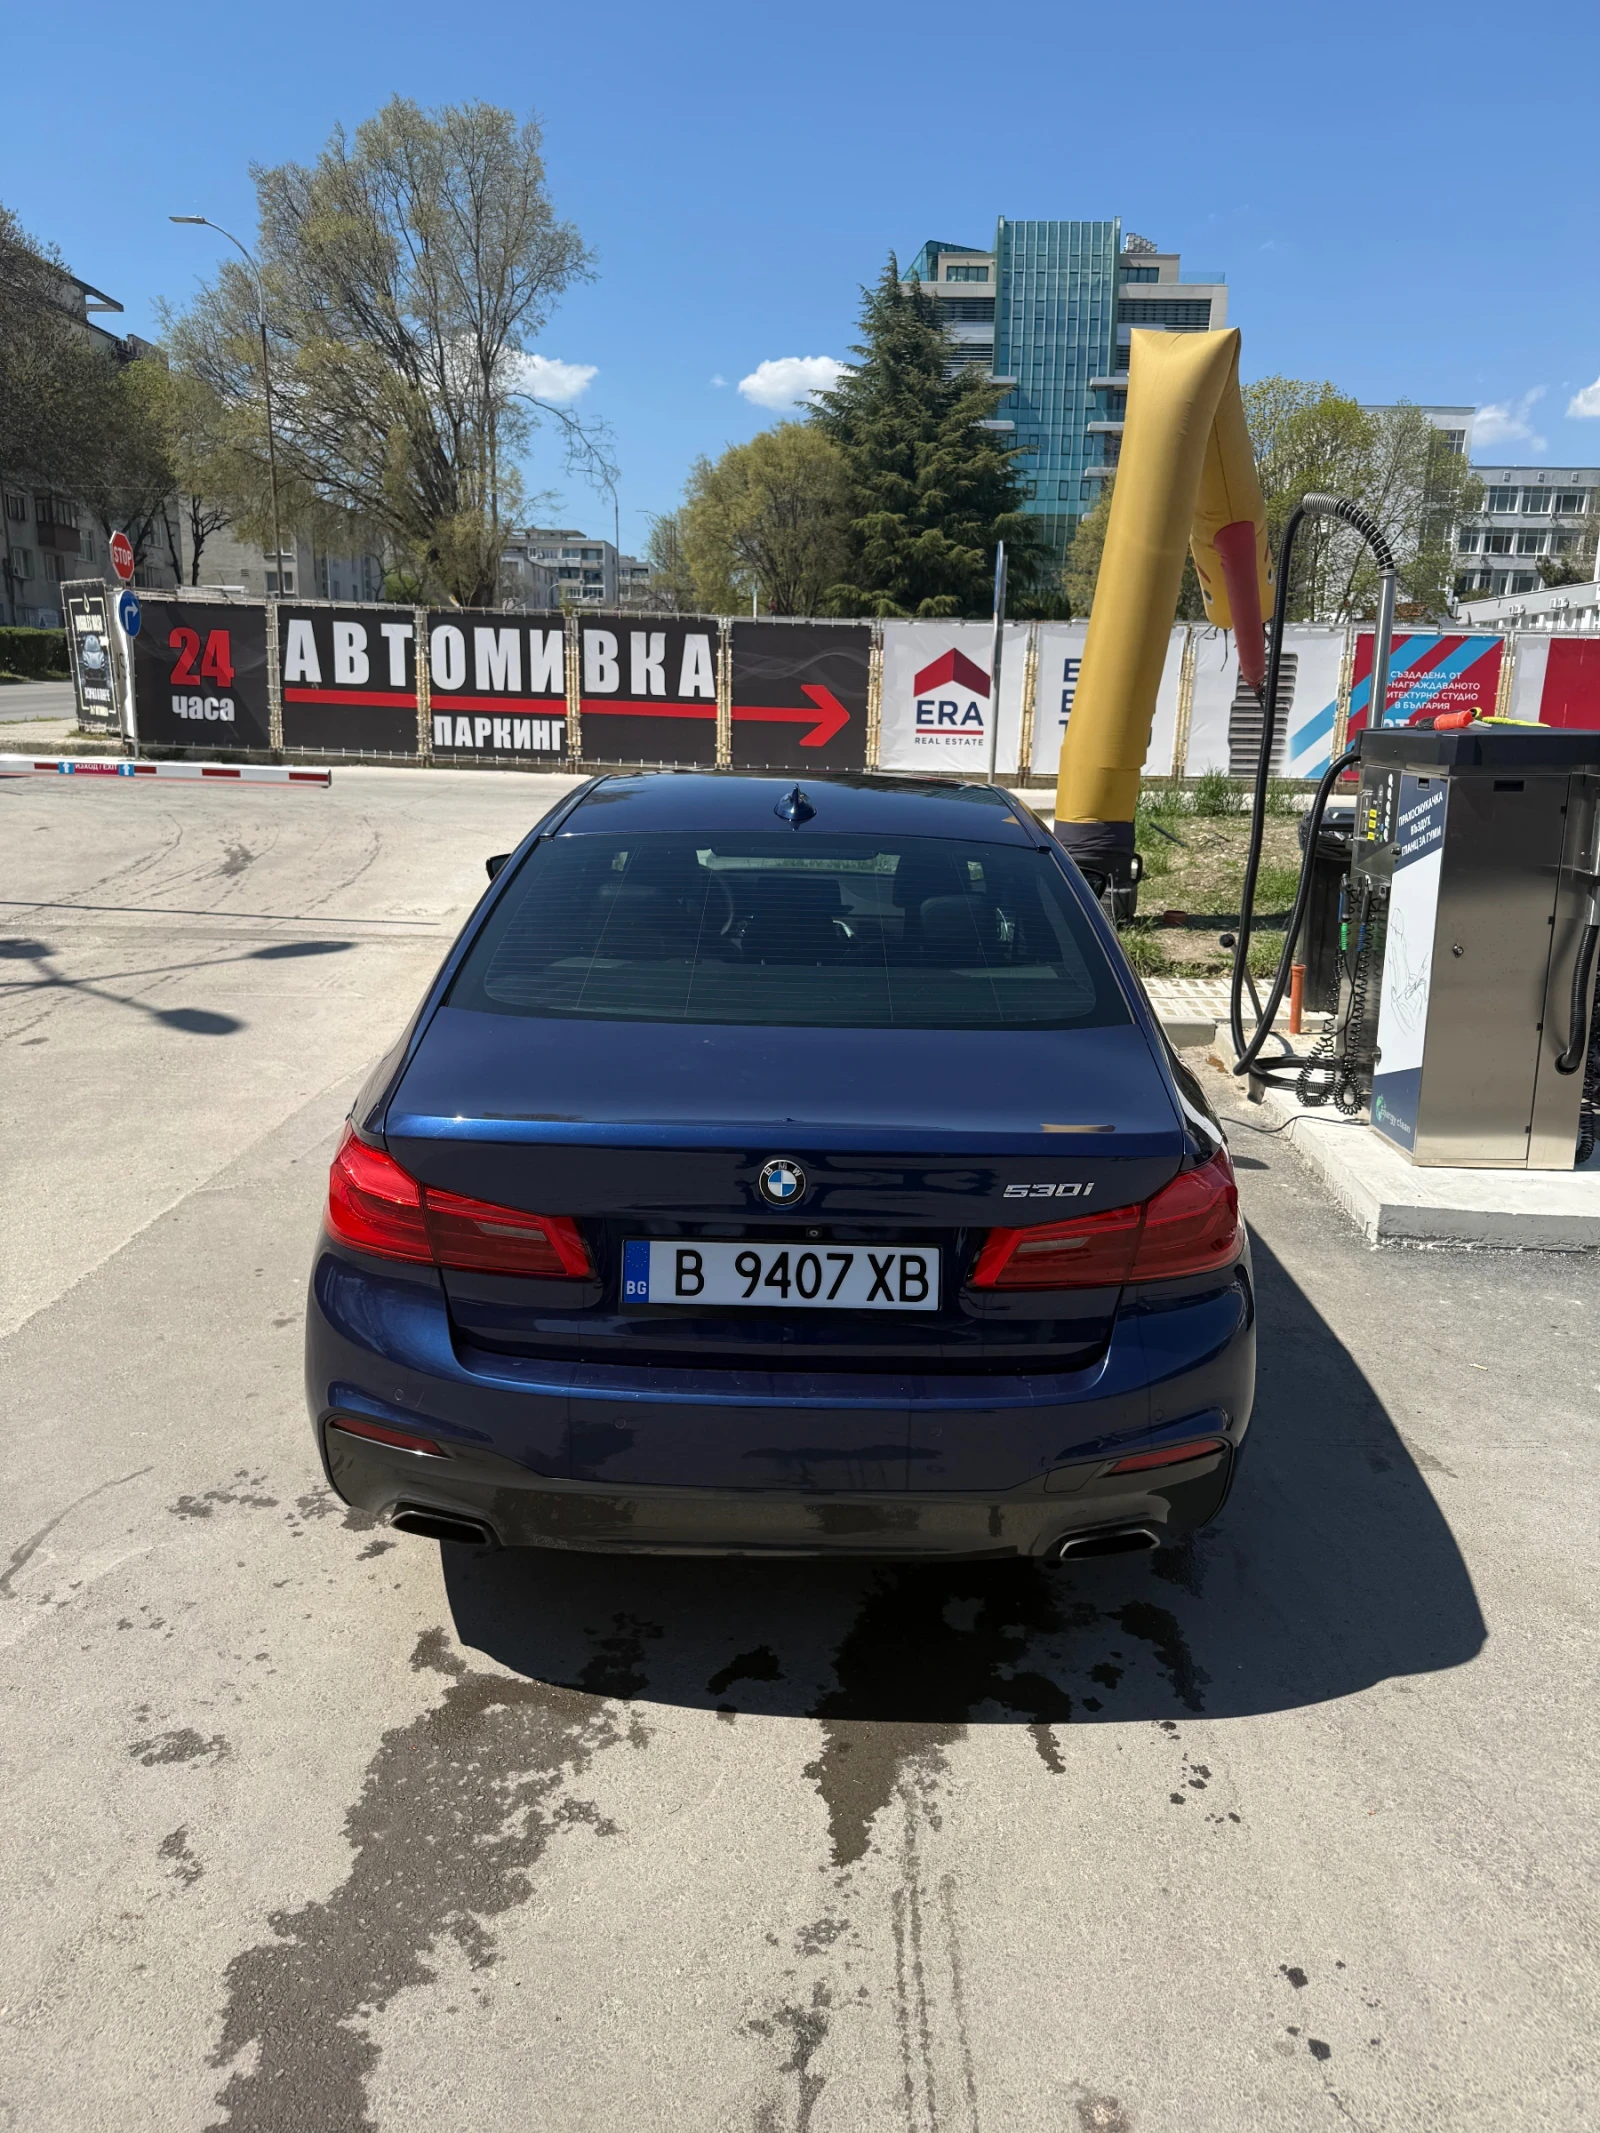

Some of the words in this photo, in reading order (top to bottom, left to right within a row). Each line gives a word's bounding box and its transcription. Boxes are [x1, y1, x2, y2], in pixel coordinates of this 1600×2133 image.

[114, 546, 132, 566] STOP
[169, 627, 235, 688] 24
[284, 619, 716, 698] АВТОМИВКА
[1390, 670, 1446, 680] СЪЗДАДЕНА
[1449, 672, 1462, 680] ОТ
[1387, 681, 1480, 691] -НАГРАЖДАВАНОТО
[1386, 691, 1440, 700] ИТЕКТУРНО
[1441, 692, 1479, 701] СТУДИО
[172, 695, 235, 722] часа
[916, 700, 984, 727] ERA
[1394, 701, 1401, 709] В
[1403, 702, 1450, 710] БЪЛГАРИЯ
[433, 714, 565, 751] ПАРКИНГ
[915, 737, 941, 745] REAL
[945, 738, 984, 746] ESTATE
[1003, 1182, 1095, 1198] 530i
[675, 1249, 705, 1297] B
[734, 1251, 854, 1300] 9407
[626, 1280, 647, 1295] BG
